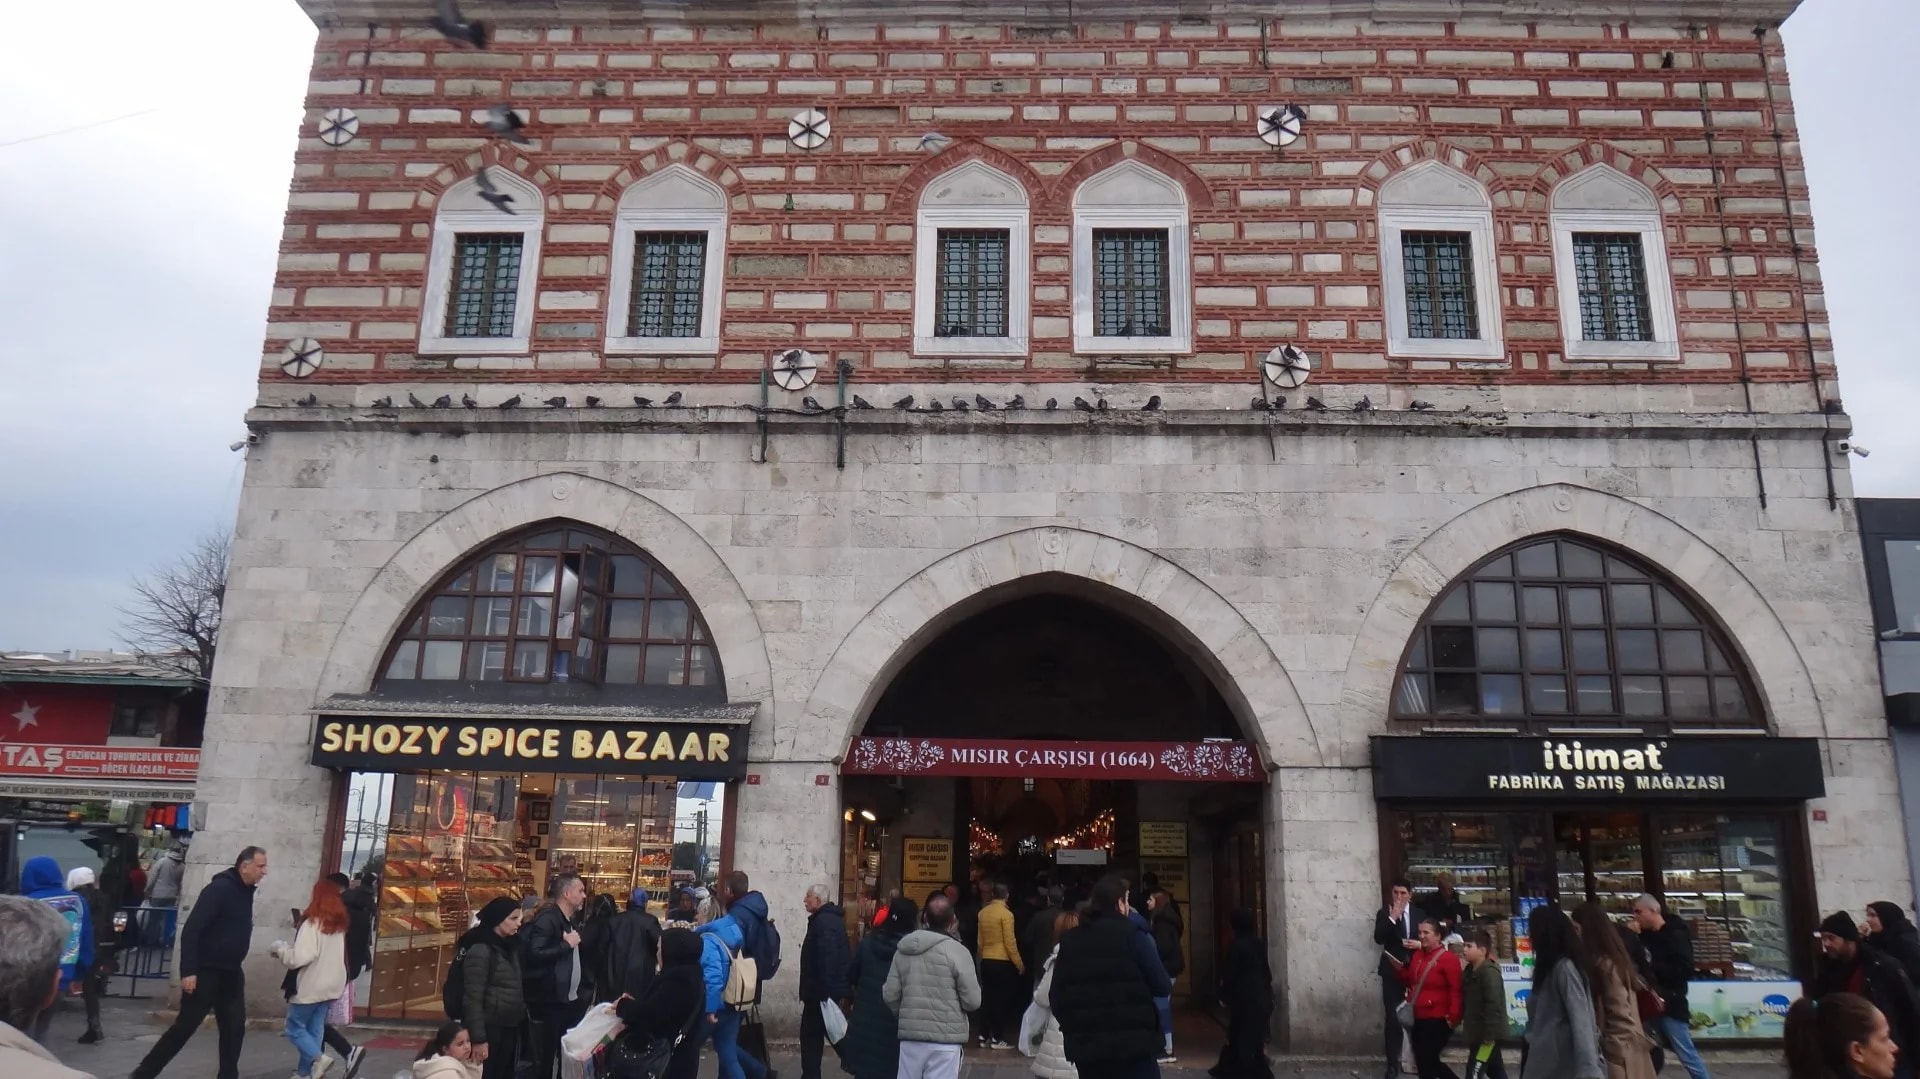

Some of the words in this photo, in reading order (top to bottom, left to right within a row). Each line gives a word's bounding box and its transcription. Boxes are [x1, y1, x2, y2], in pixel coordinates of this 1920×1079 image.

[321, 722, 449, 755] SHOZY
[457, 726, 560, 758] SPICE
[572, 729, 730, 762] BAZAAR
[0, 745, 64, 773] TAŞ
[164, 753, 174, 762] VE
[951, 748, 1010, 764] MISIR
[1015, 749, 1095, 769] ÇARŞISI
[1101, 752, 1155, 769] (1664)
[1543, 741, 1664, 771] itimat
[1488, 773, 1564, 790] FABRİKA
[1575, 775, 1625, 793] SATIŞ
[1636, 773, 1725, 790] MAĞAZASI
